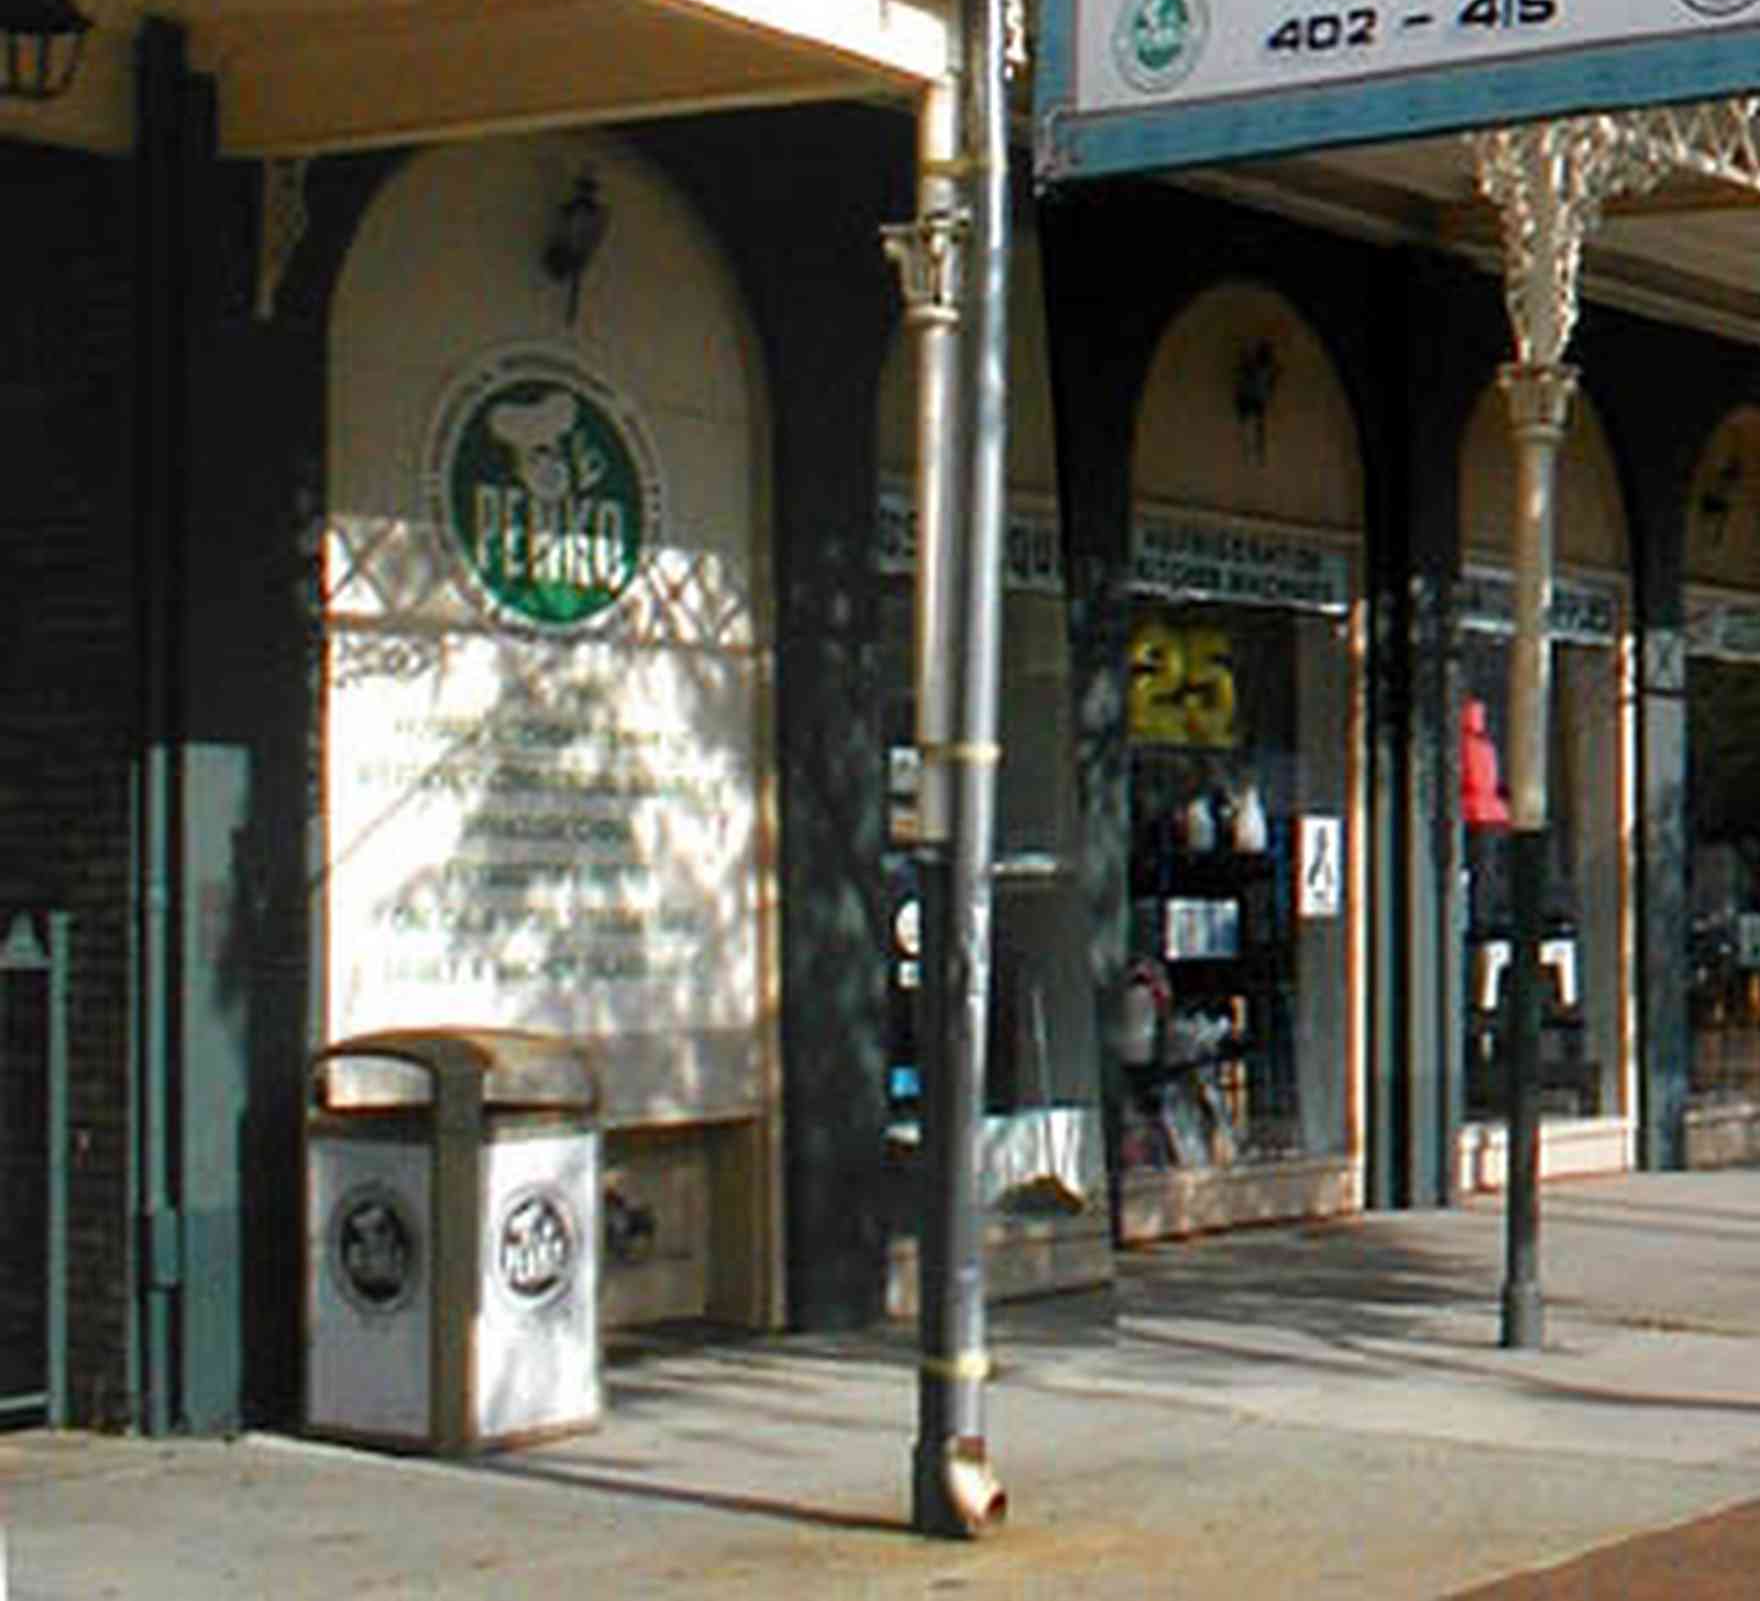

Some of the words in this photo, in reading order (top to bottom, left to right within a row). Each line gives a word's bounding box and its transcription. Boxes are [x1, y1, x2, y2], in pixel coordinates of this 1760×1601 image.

[1267, 8, 1377, 51] 402
[476, 483, 628, 591] PENKO
[1127, 624, 1236, 742] 25
